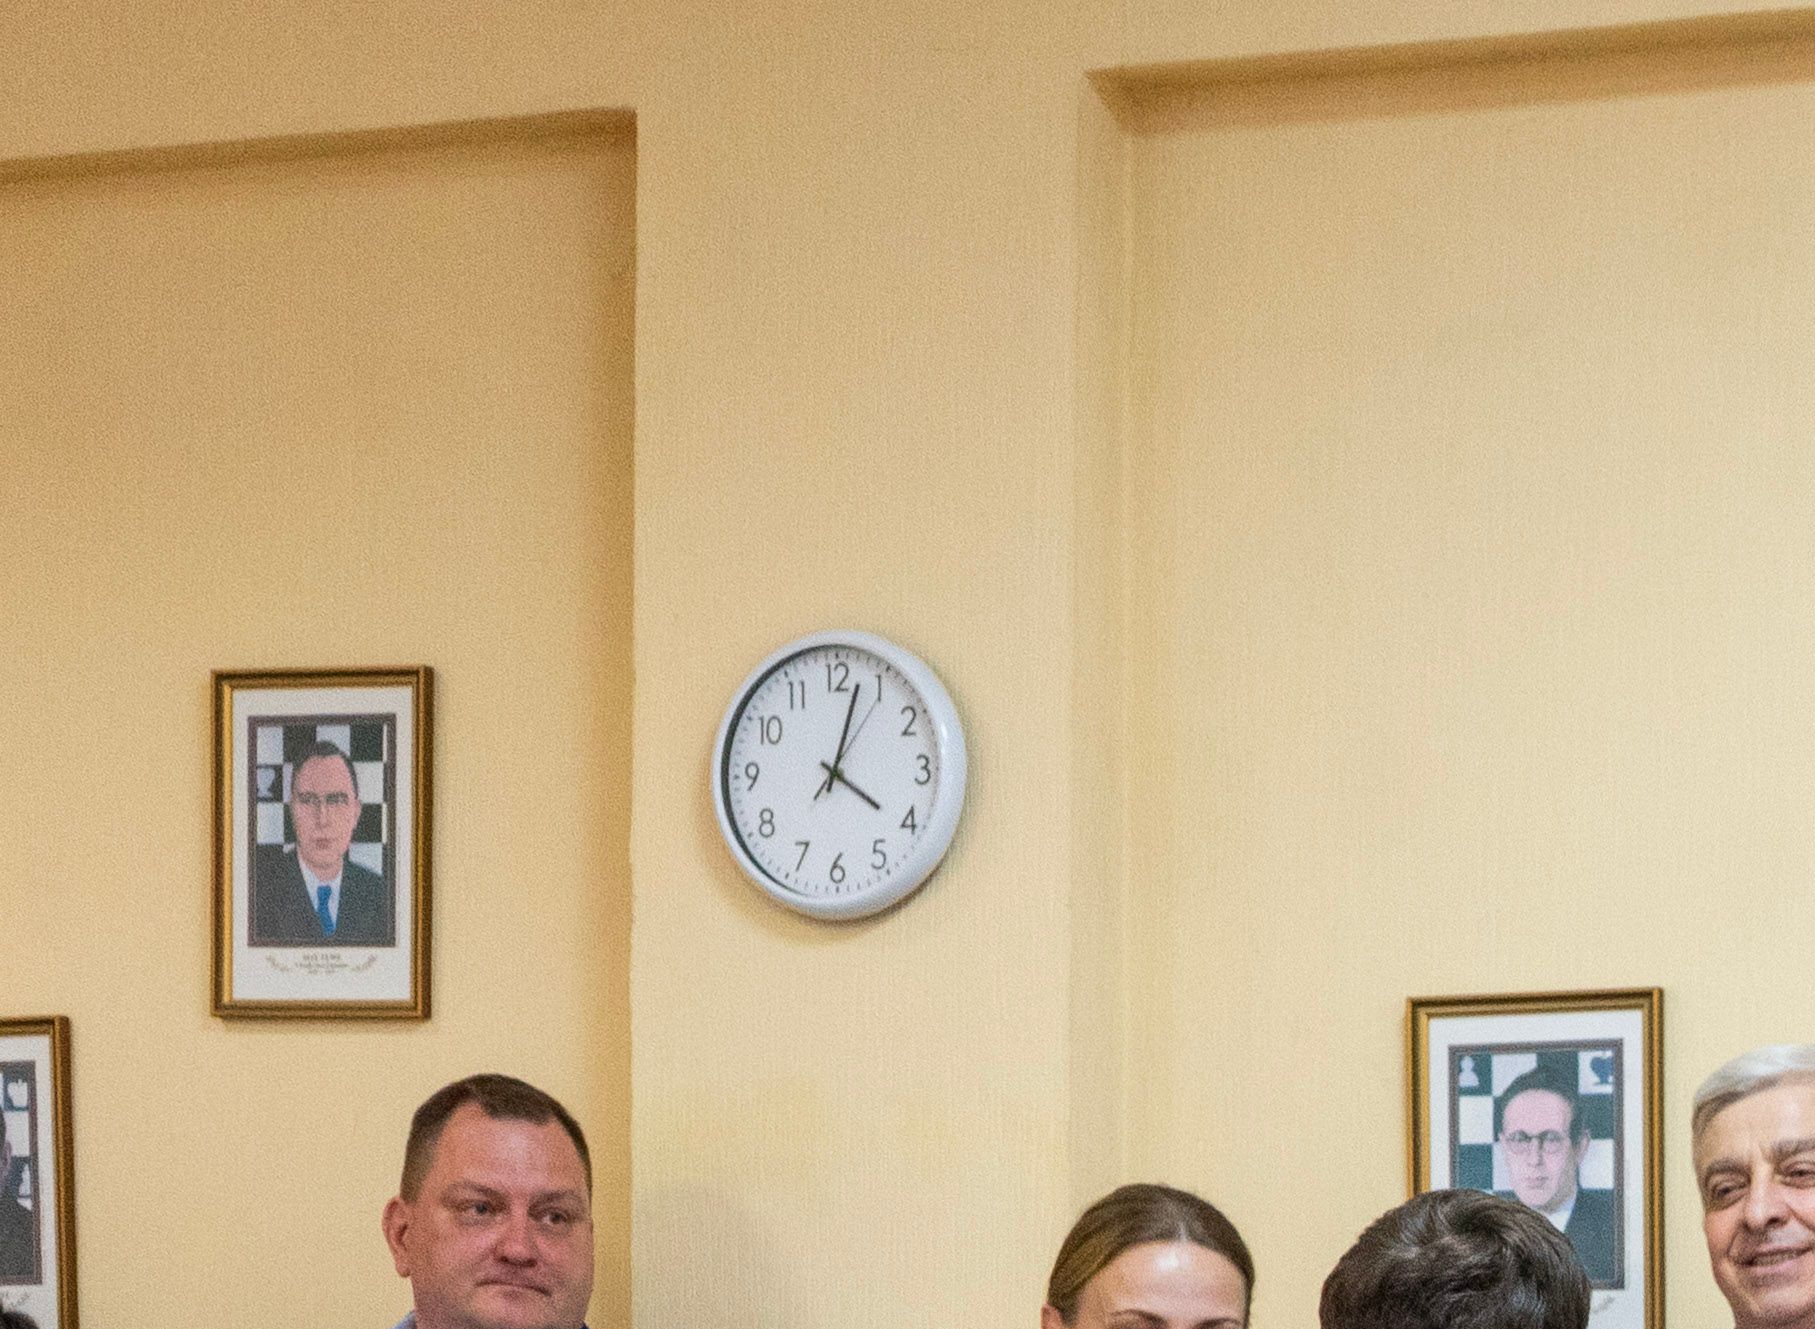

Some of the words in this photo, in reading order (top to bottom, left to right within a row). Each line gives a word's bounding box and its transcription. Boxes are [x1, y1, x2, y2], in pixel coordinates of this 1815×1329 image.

[826, 662, 849, 692] 12
[875, 674, 882, 702] 1
[789, 681, 805, 710] 11
[760, 715, 783, 745] 10
[901, 706, 917, 736] 2
[745, 762, 760, 791] 9
[914, 754, 931, 785] 3
[759, 808, 775, 838] 8
[901, 805, 917, 835] 4
[795, 841, 810, 872] 7
[830, 852, 846, 883] 6
[871, 838, 887, 870] 5
